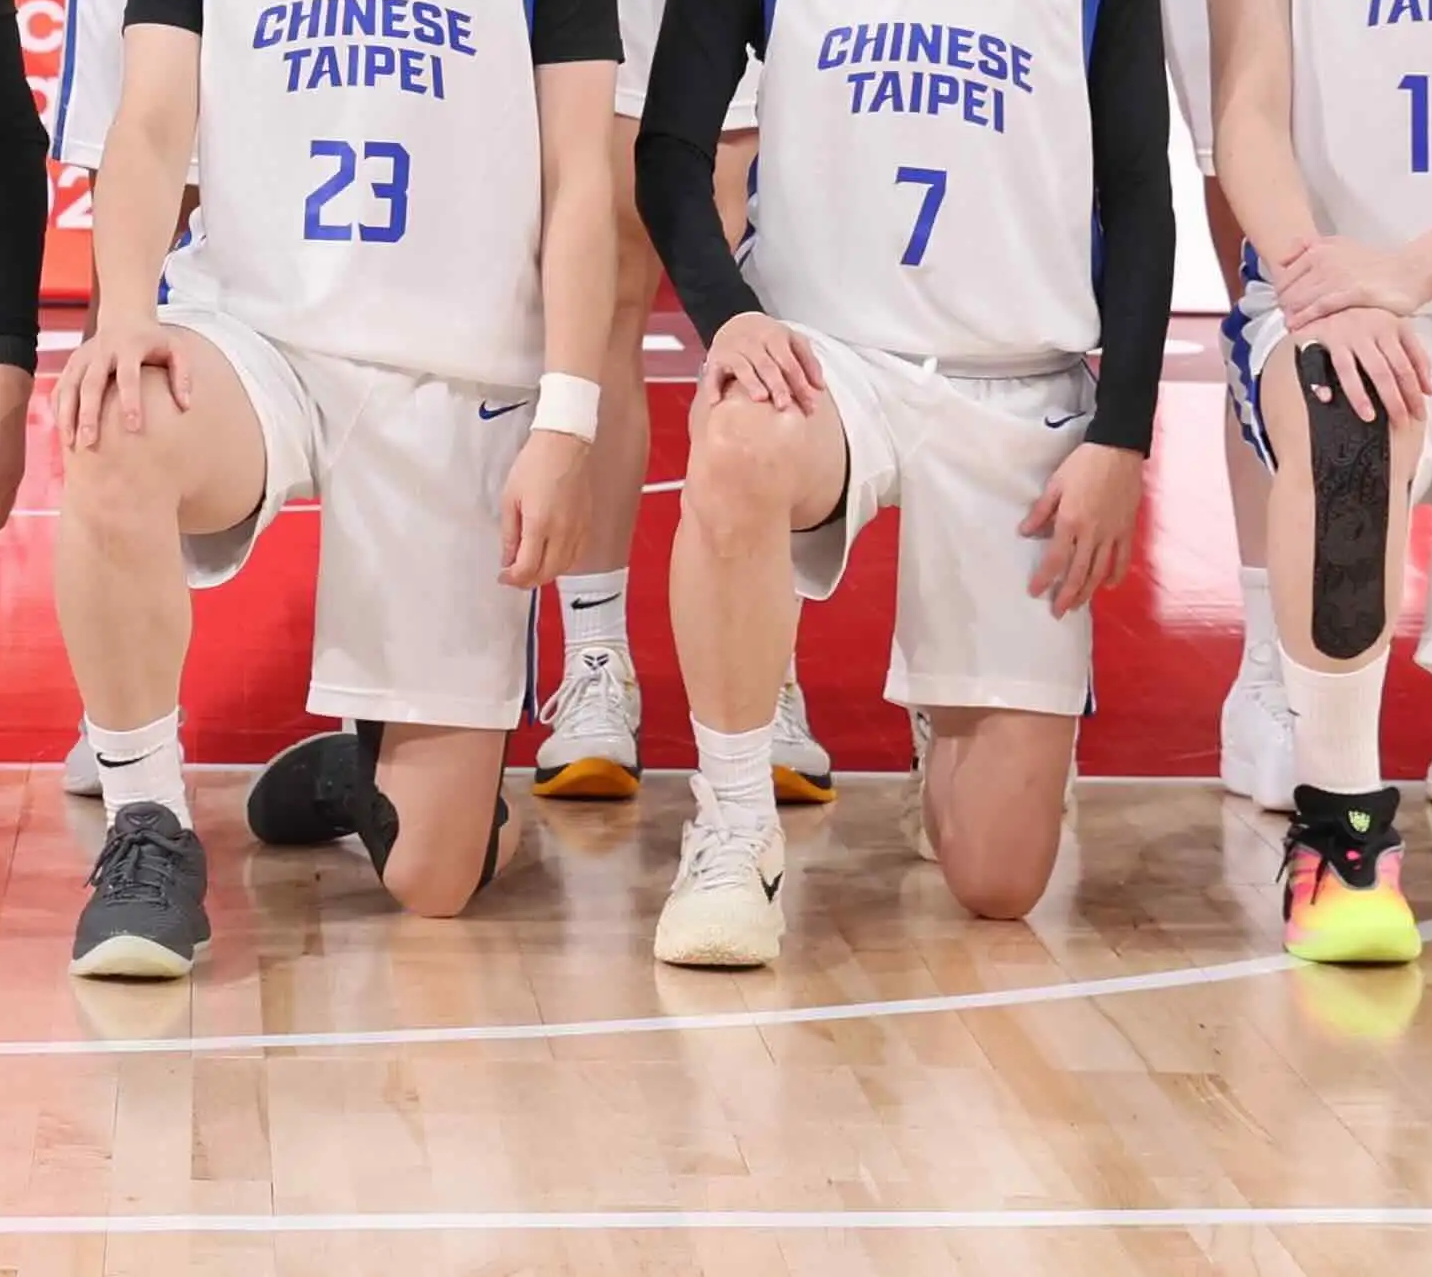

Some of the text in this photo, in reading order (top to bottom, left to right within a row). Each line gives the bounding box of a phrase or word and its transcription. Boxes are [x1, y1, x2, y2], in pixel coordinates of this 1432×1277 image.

[283, 44, 445, 100] TAIPEI
[817, 22, 1034, 93] CHINESE
[847, 70, 1006, 134] TAIPEI
[303, 140, 411, 243] 23
[895, 166, 948, 267] 7
